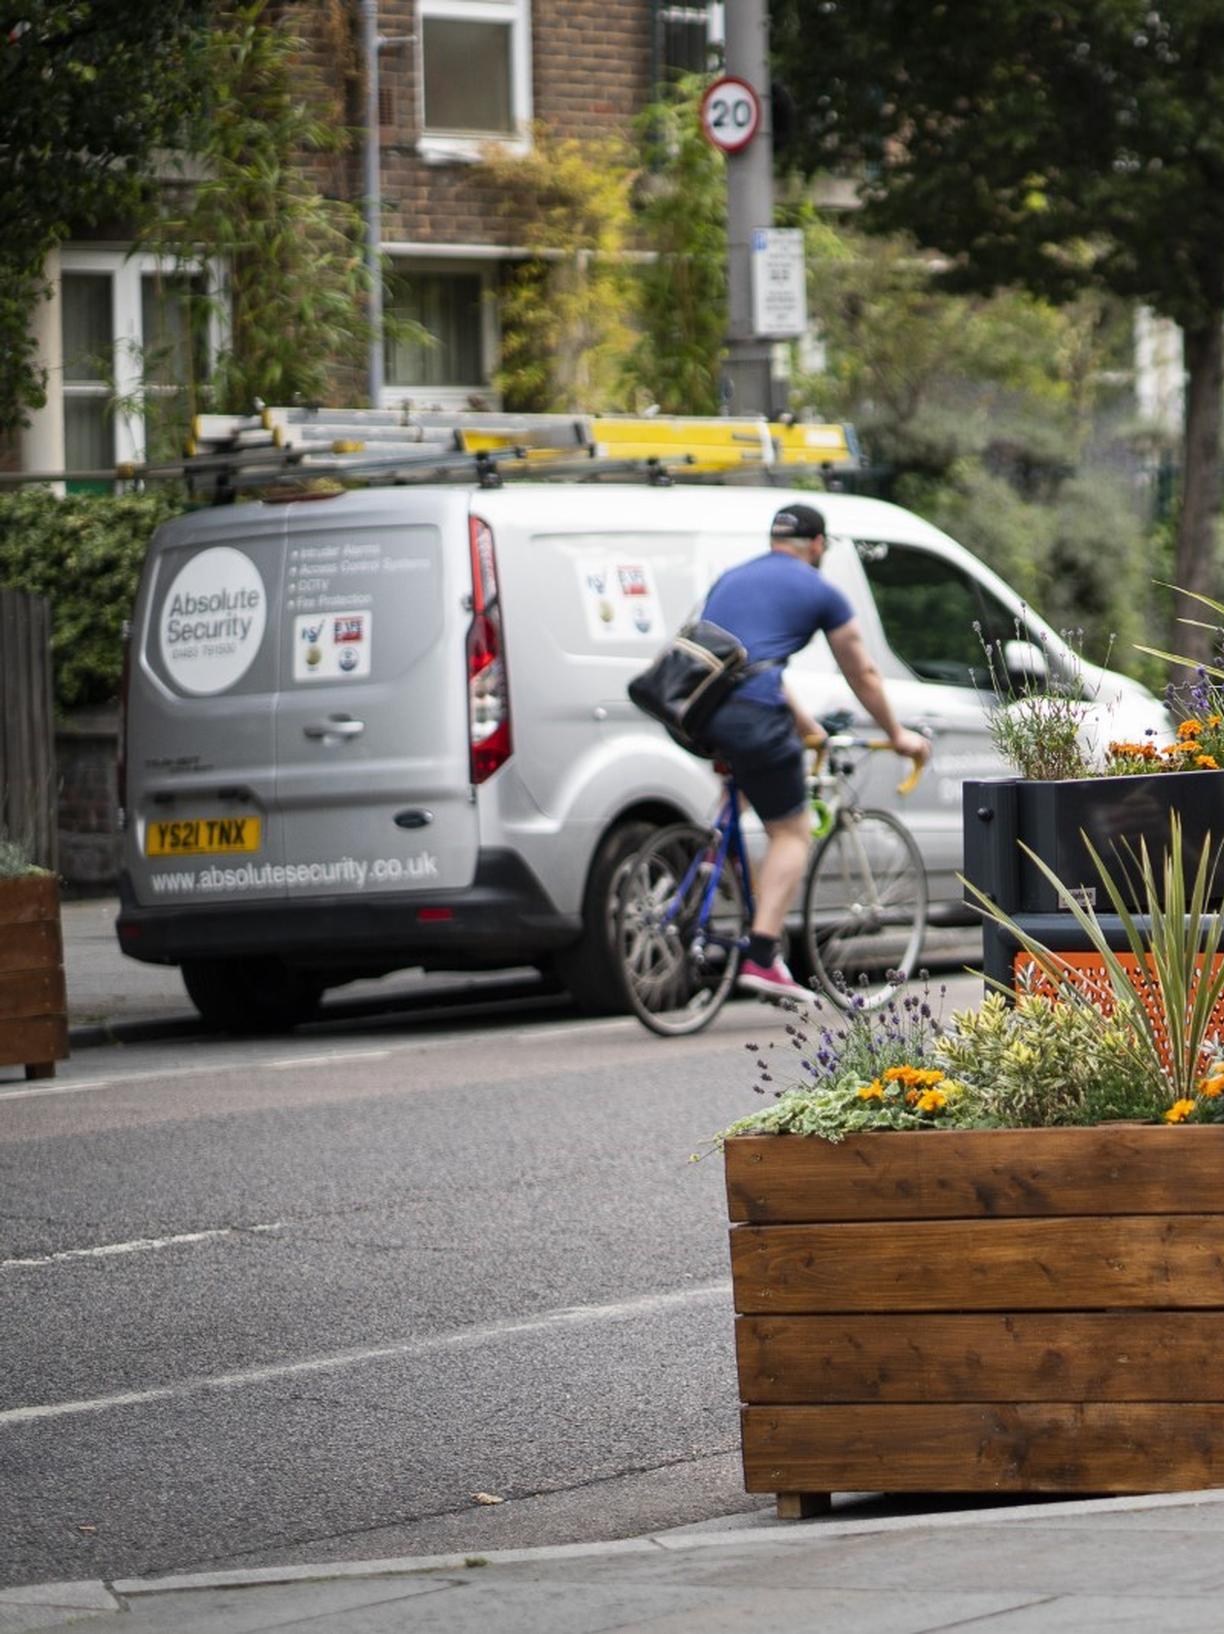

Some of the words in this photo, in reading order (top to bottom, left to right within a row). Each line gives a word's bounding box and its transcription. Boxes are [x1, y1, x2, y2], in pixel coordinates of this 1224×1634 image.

[711, 99, 751, 128] 20
[169, 587, 260, 618] Absolute
[167, 611, 254, 644] Security
[158, 821, 200, 849] YS21
[206, 818, 247, 847] TNX
[151, 852, 437, 891] www.absolutesecurity.co.uk
